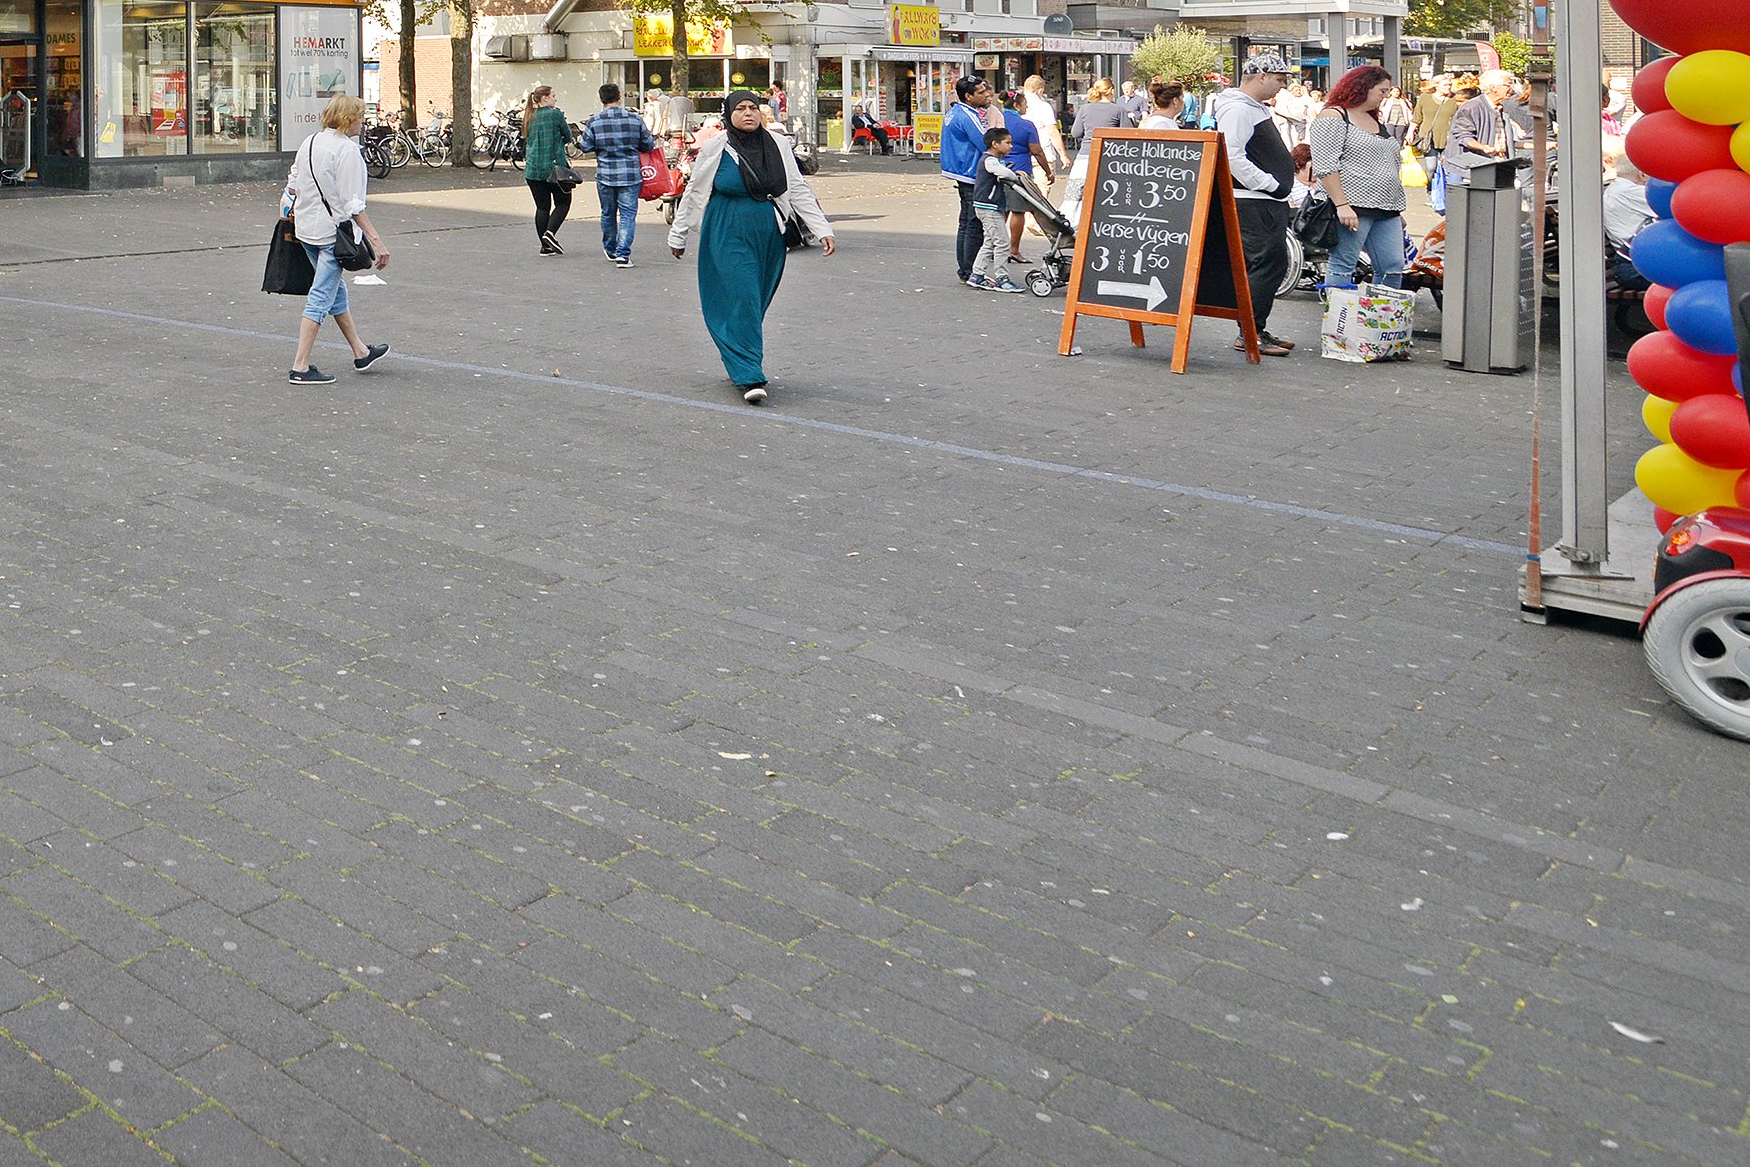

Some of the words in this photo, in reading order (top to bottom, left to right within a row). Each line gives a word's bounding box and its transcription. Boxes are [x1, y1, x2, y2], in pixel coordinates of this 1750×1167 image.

[46, 34, 76, 44] DAMES
[911, 27, 930, 40] WOK
[294, 37, 345, 49] HEMARKT
[326, 50, 348, 59] korting
[295, 113, 303, 122] in
[304, 113, 316, 122] de
[1141, 142, 1202, 162] Hollandse
[1108, 159, 1195, 182] aardbeien
[1101, 179, 1119, 206] 2
[1091, 246, 1109, 271] 3
[1337, 306, 1348, 335] ACTION
[1380, 331, 1408, 341] ACTION
